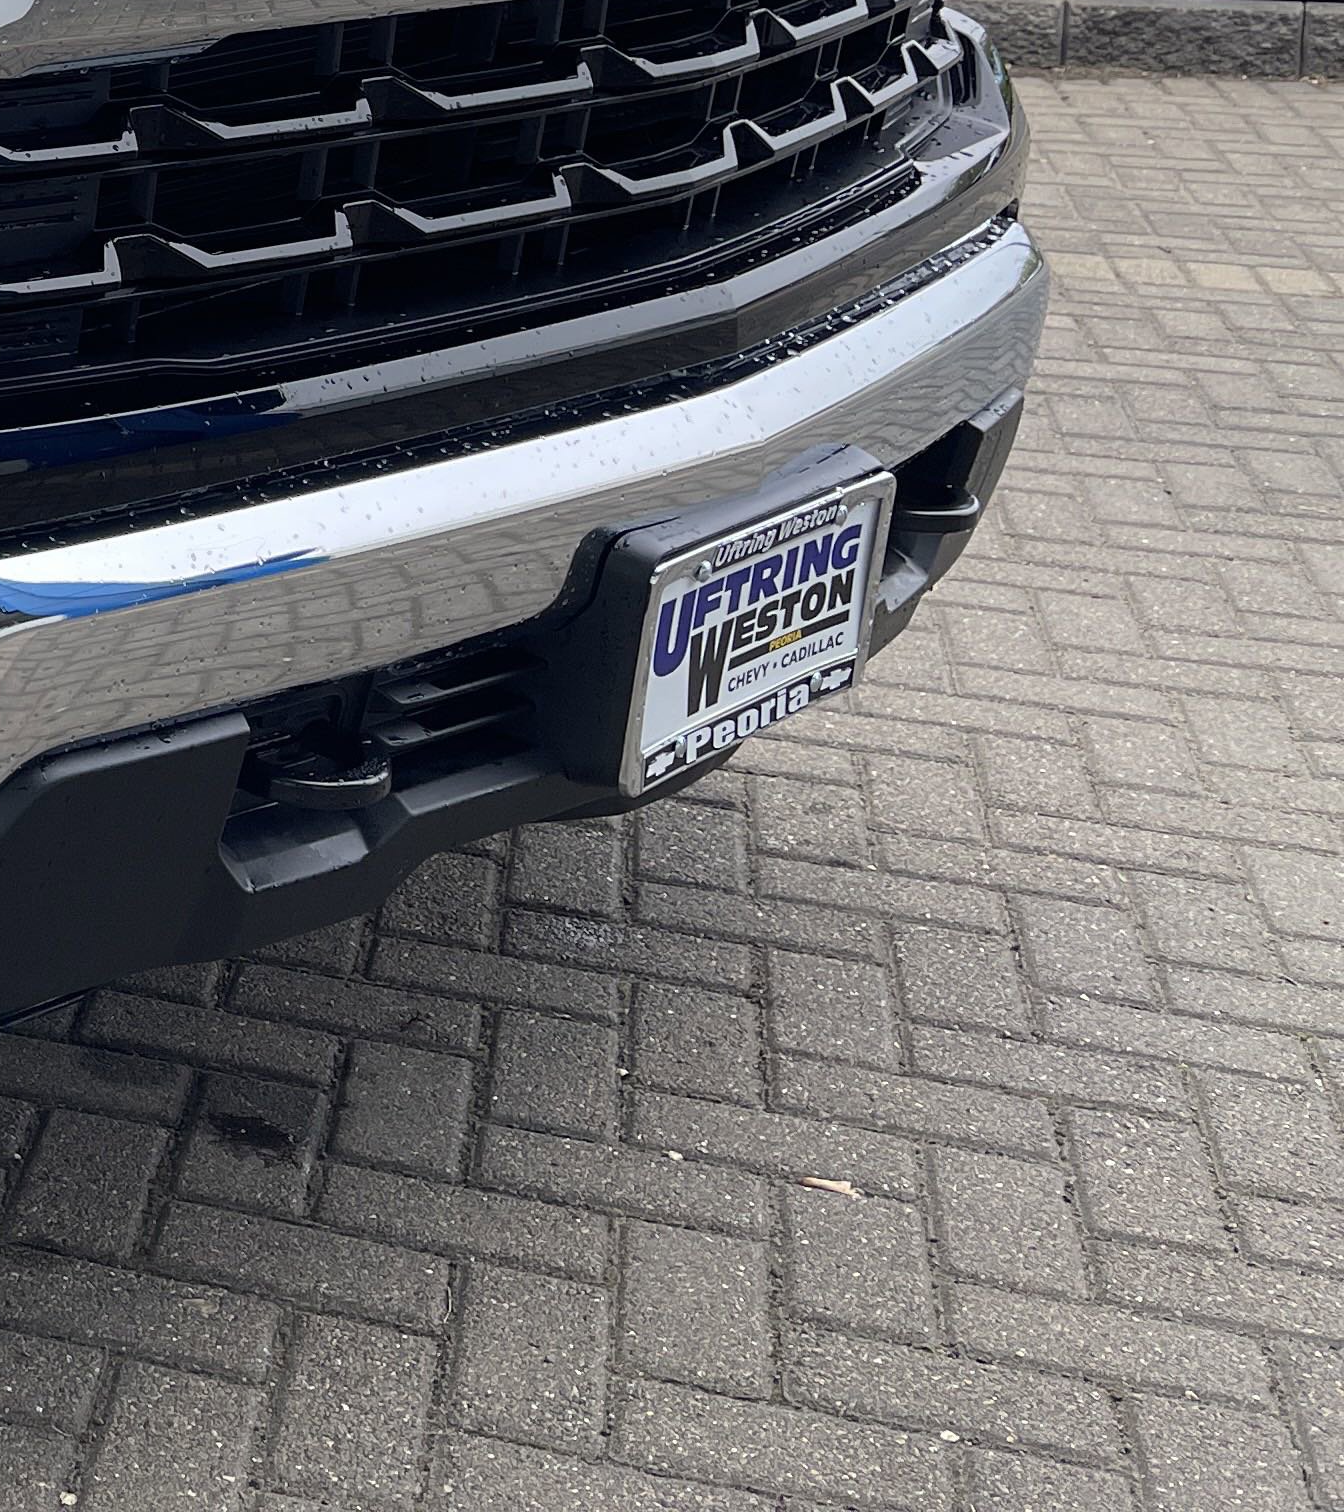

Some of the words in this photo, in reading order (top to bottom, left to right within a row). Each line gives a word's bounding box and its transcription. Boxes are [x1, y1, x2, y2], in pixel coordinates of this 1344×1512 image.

[778, 505, 838, 541] Weston
[653, 524, 862, 677] UFTRING
[687, 570, 855, 717] WESTON
[728, 661, 770, 692] CHEVY
[781, 631, 844, 668] CADILLAC
[768, 630, 803, 652] PEORIA
[685, 683, 811, 763] Peoria
